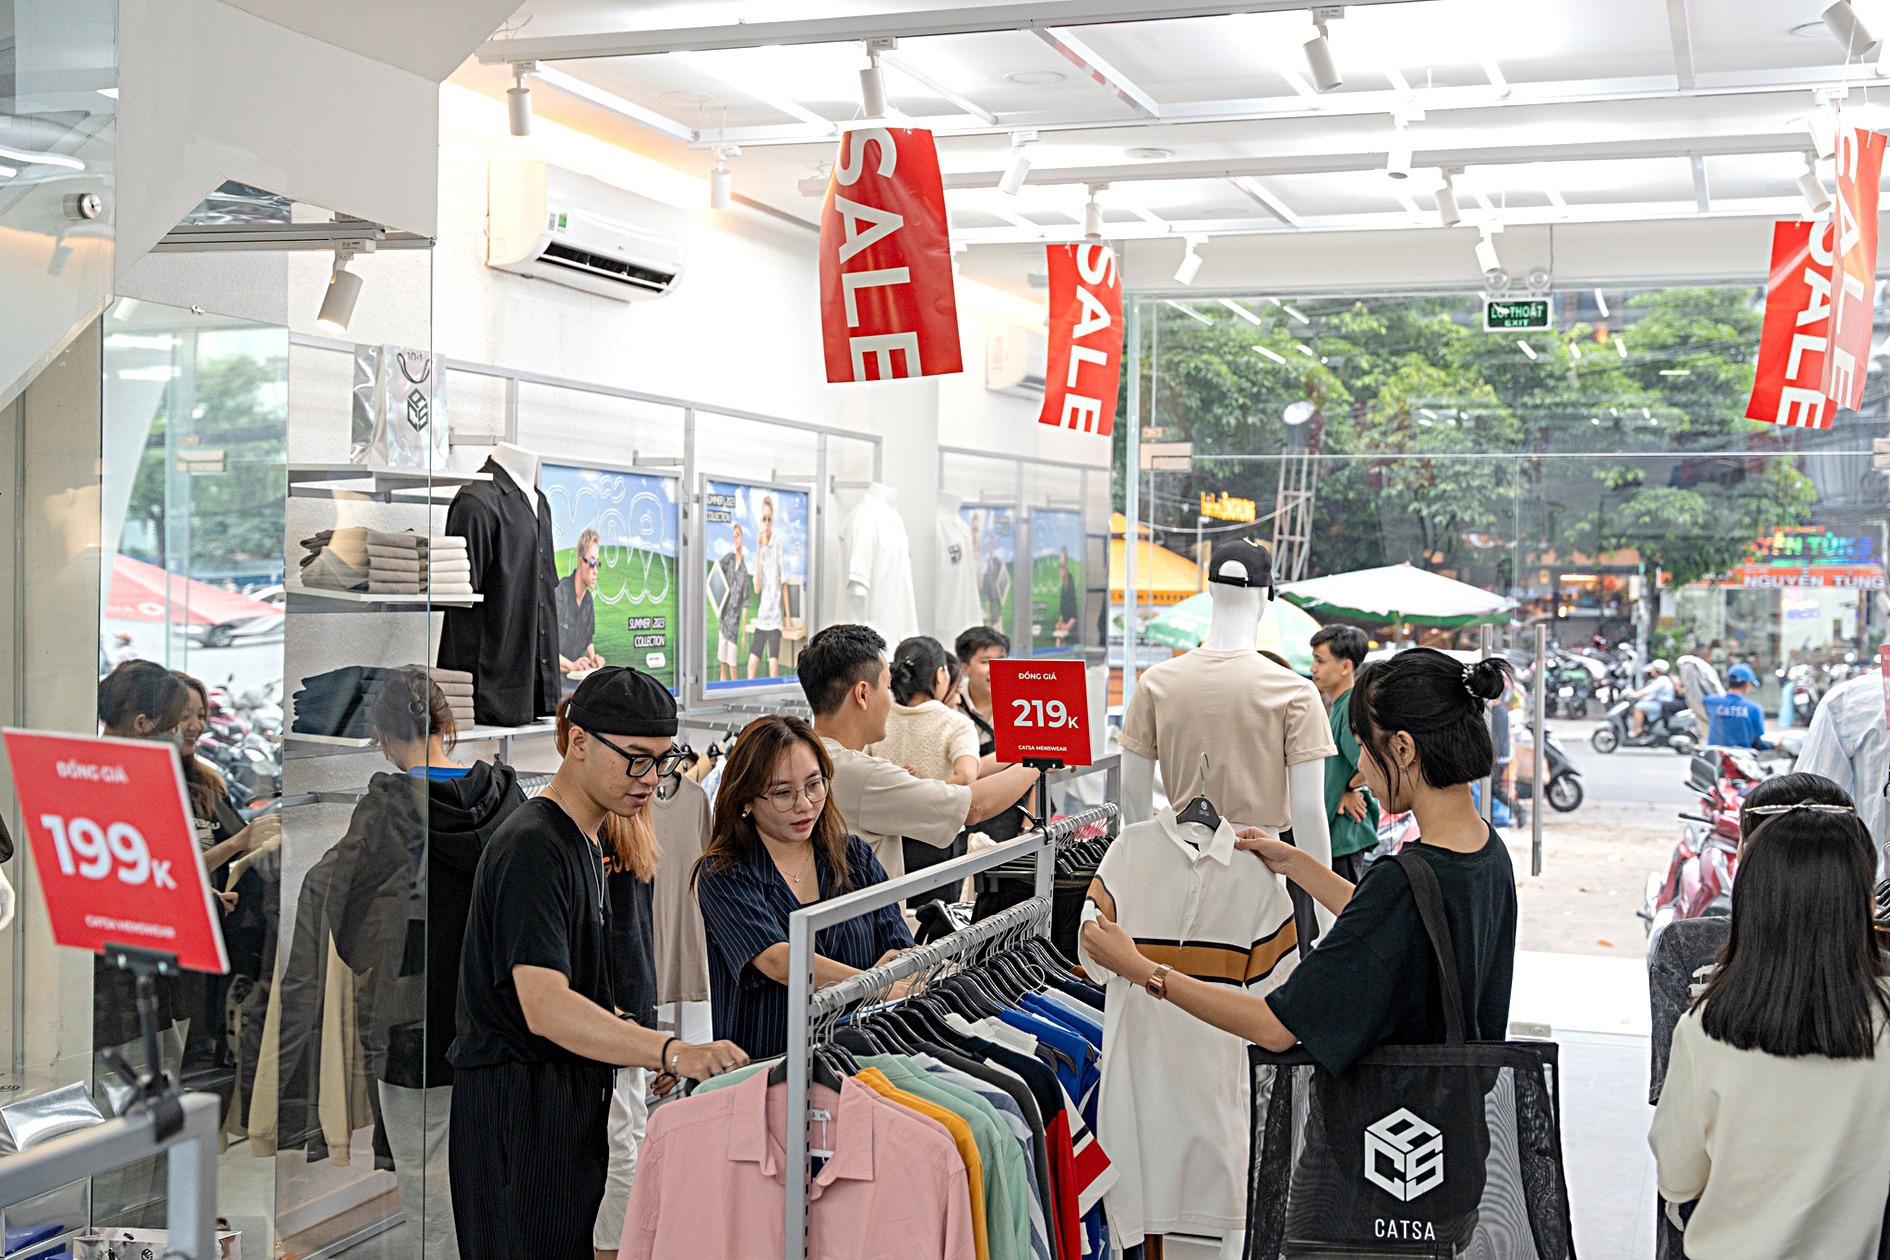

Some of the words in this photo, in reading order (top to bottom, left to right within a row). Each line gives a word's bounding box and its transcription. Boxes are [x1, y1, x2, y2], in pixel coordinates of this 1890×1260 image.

[834, 127, 922, 382] SALE
[1504, 319, 1529, 327] EXIT
[1059, 243, 1117, 435] SALE
[629, 617, 650, 629] SUMMER
[634, 635, 665, 647] COLLECTION
[1374, 1218, 1436, 1241] CATSA
